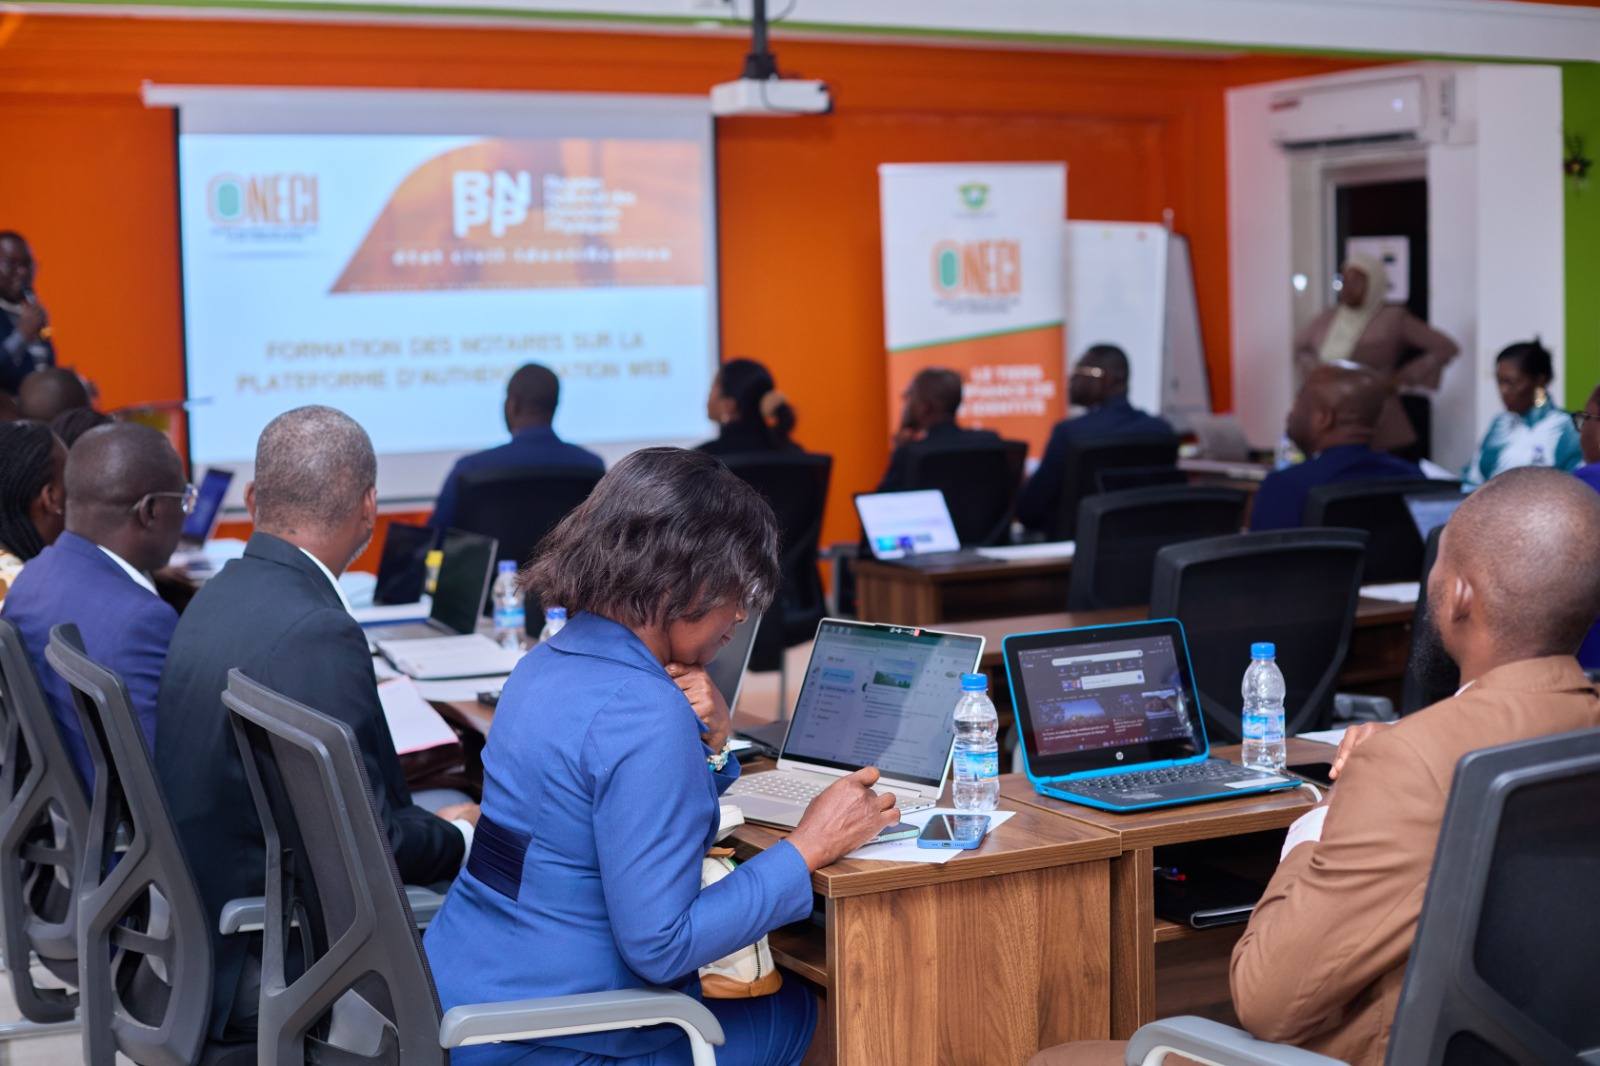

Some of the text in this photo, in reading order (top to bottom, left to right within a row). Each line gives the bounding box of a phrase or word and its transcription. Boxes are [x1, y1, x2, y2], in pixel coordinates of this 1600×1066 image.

[265, 338, 402, 361] FORMATION
[410, 336, 451, 357] DES
[573, 331, 613, 349] SUR
